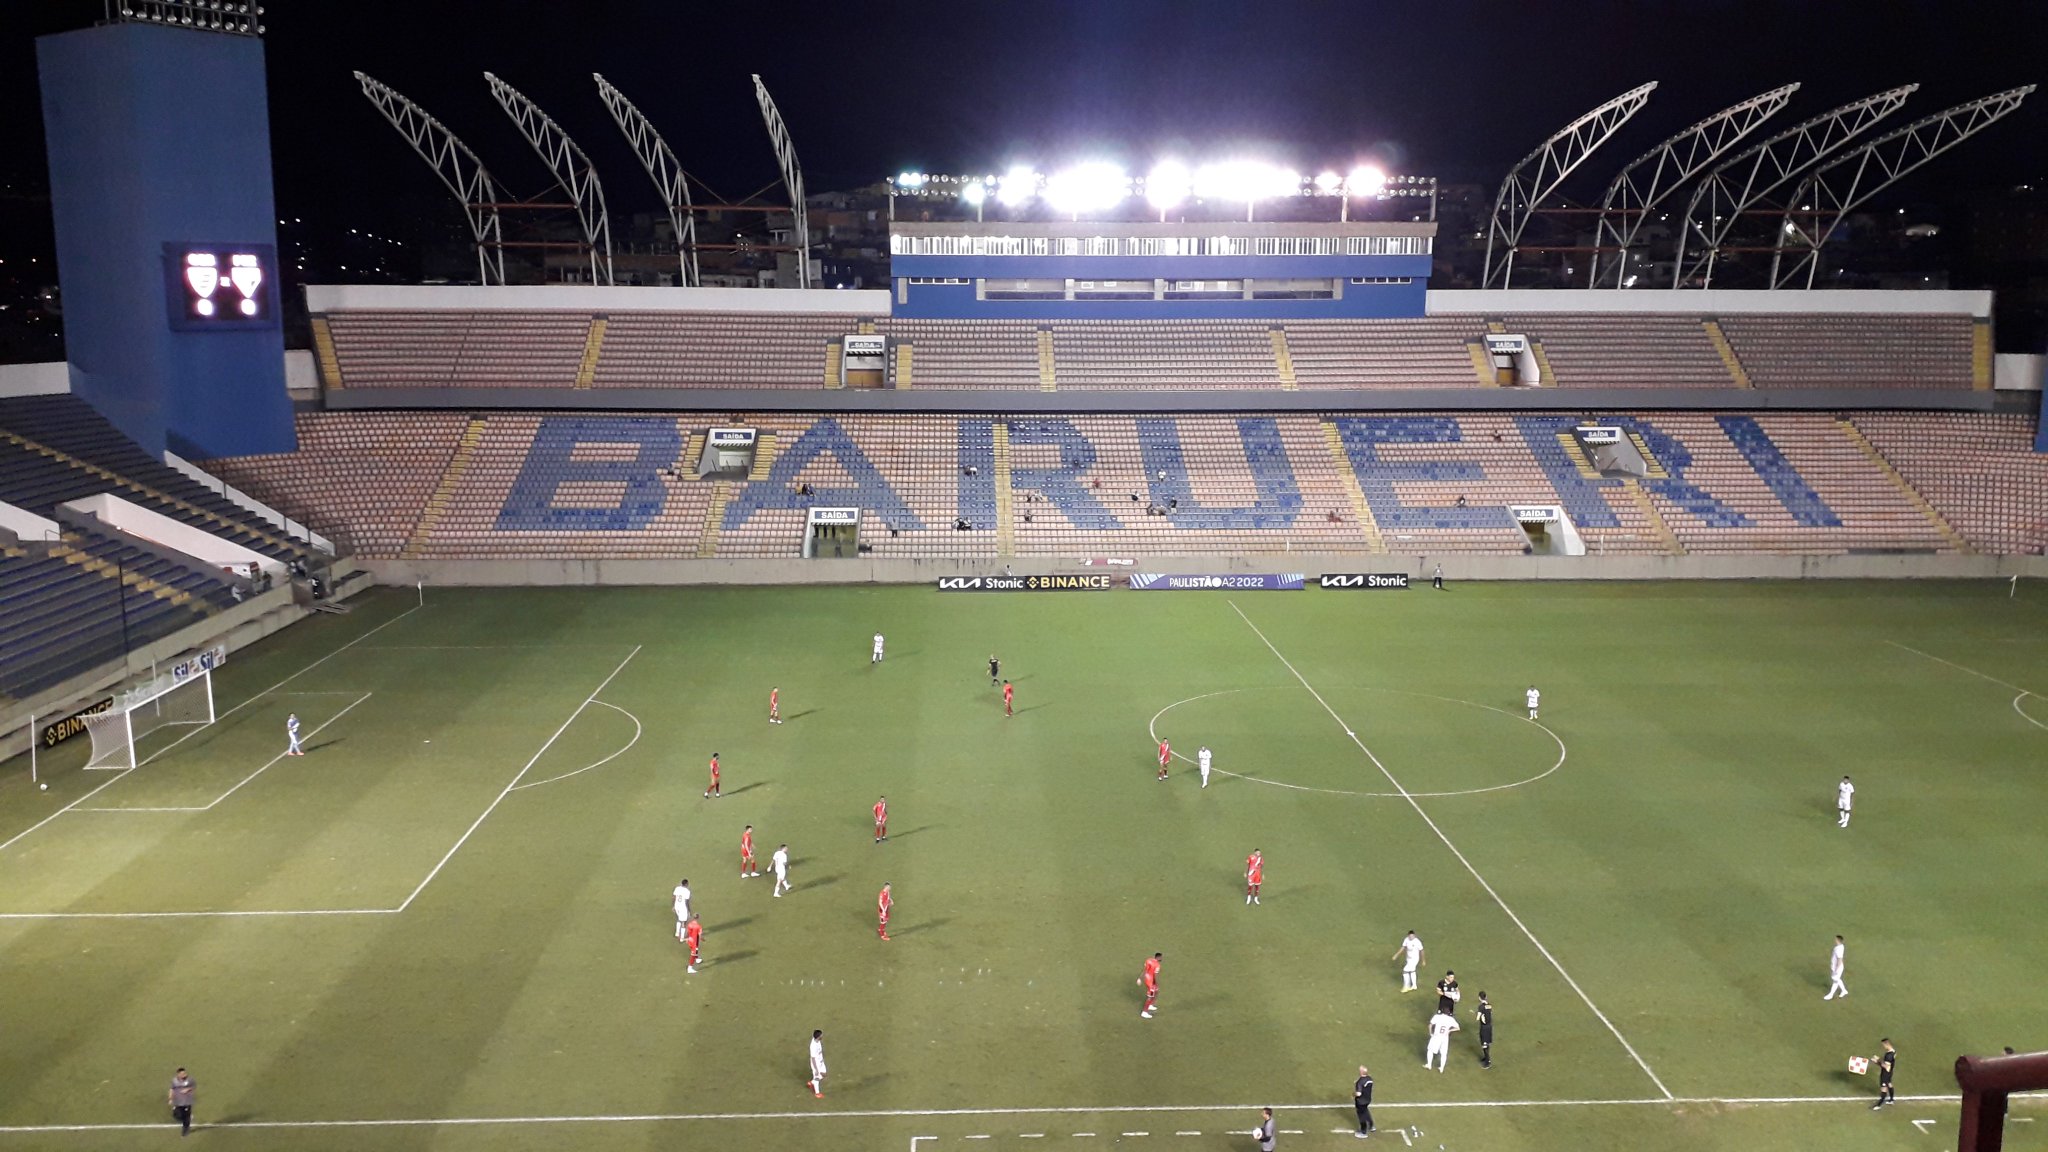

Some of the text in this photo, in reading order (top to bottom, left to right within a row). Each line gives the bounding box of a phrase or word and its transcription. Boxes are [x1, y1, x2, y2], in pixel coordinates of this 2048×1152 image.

[494, 416, 1844, 530] BARUERI
[821, 510, 849, 519] SAÍDA
[1520, 509, 1547, 517] SAÍDA
[986, 577, 1024, 589] Stonic
[1040, 576, 1110, 589] BINANCE
[1236, 577, 1264, 587] 2022
[1368, 575, 1407, 587] Stonic
[1439, 1025, 1446, 1034] 6
